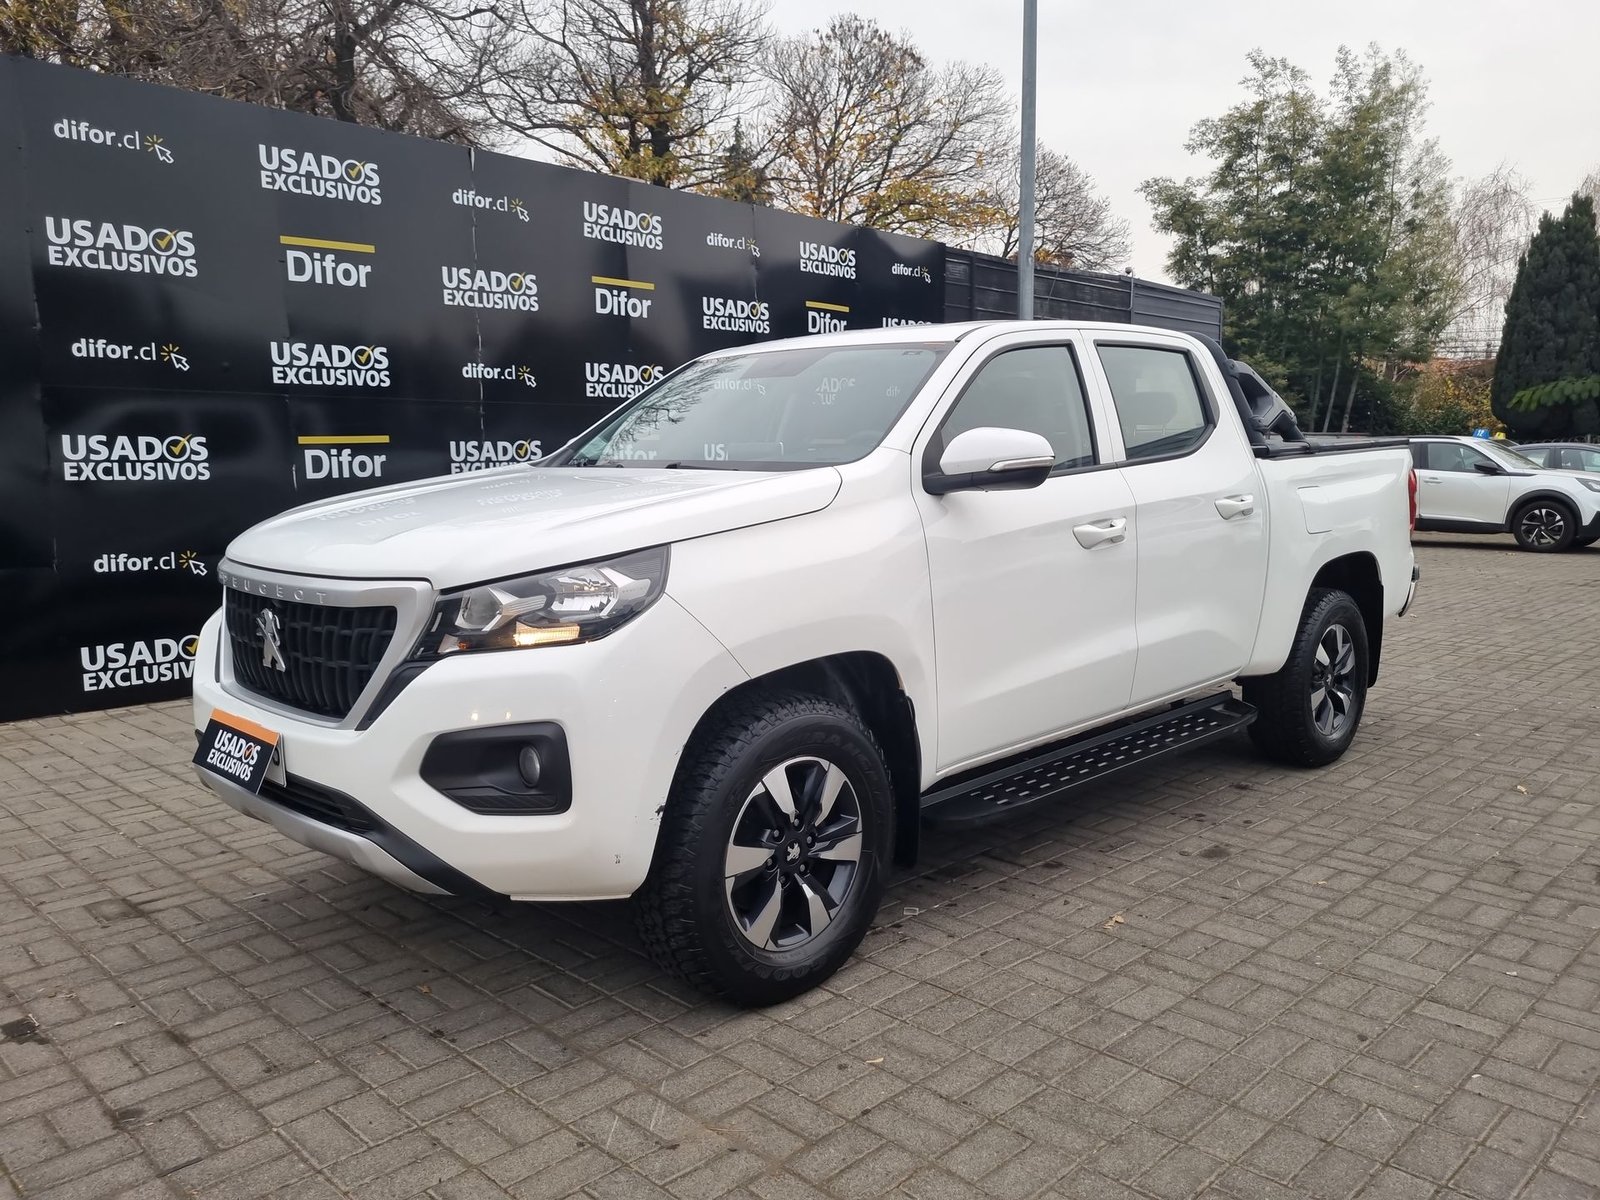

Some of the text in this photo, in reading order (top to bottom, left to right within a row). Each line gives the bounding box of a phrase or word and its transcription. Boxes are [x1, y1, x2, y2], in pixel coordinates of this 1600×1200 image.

[54, 119, 140, 150] difor.cl
[258, 144, 380, 186] USADOS
[260, 170, 382, 205] EXCLUSIVOS
[452, 188, 508, 212] difor.cl
[583, 201, 662, 235] USADOS
[45, 216, 196, 257] USADOS
[583, 222, 663, 250] EXCLUSIVOS
[706, 232, 745, 250] difor.cl
[48, 245, 198, 277] EXCLUSIVOS
[800, 241, 856, 267] USADOS
[286, 250, 372, 287] Difor
[442, 266, 537, 295] USADOS
[800, 259, 856, 279] EXCLUSIVOS
[891, 263, 920, 278] difor.cl
[443, 289, 539, 312] EXCLUSIVOS
[595, 288, 651, 318] Difor
[702, 296, 769, 320] USADOS
[703, 316, 770, 334] EXCLUSIVOS
[807, 310, 847, 334] Difor
[71, 338, 156, 361] difor.cl
[270, 341, 389, 369] USADOS
[272, 367, 391, 387] EXCLUSIVOS
[462, 363, 516, 380] difor.cl
[585, 362, 664, 385] USADOS
[585, 382, 647, 398] EXCLUSI
[61, 434, 208, 462] USADOS
[449, 440, 542, 461] USADOS
[63, 462, 210, 481] EXCLUSIVOS
[304, 449, 386, 479] Difor
[93, 552, 175, 573] difor.cl
[80, 634, 200, 671] USADO
[83, 660, 195, 691] EXCLUSIV
[214, 729, 261, 765] USADOS
[206, 748, 253, 781] EXCLUSIVOS
